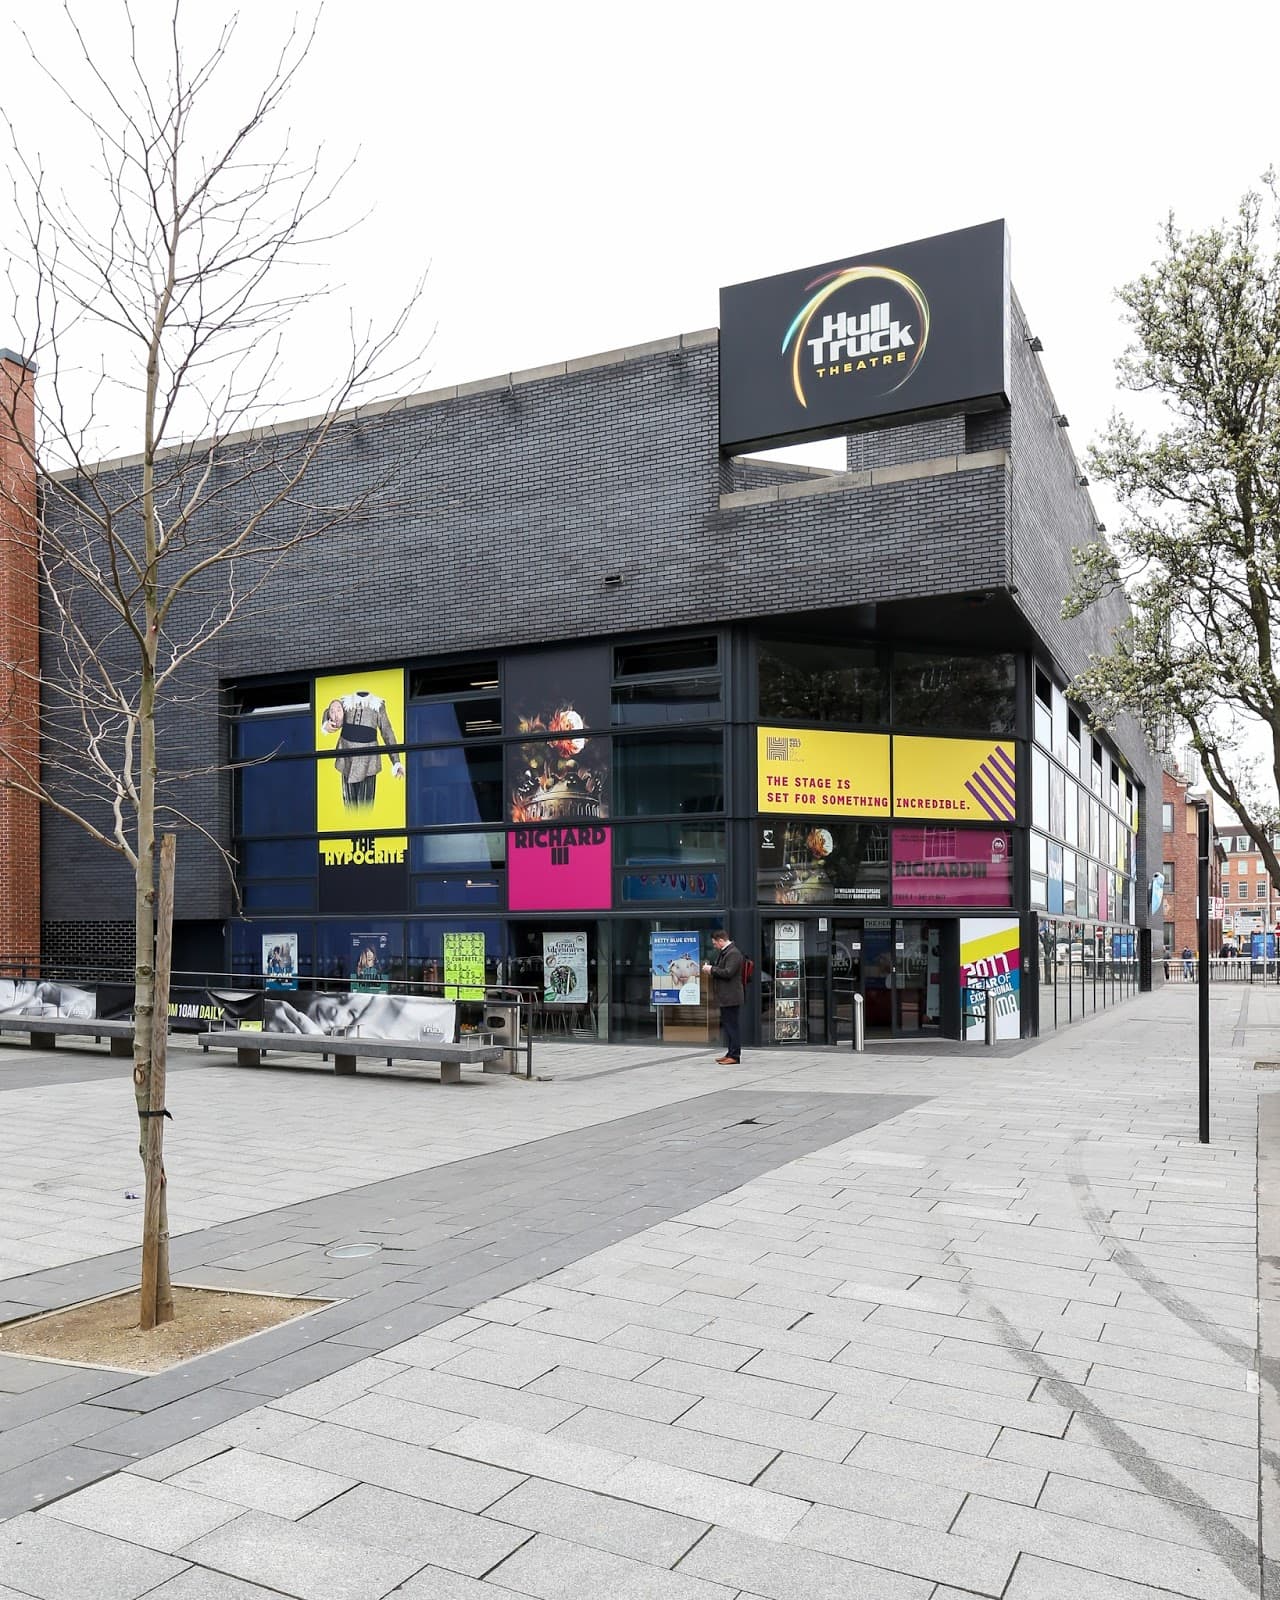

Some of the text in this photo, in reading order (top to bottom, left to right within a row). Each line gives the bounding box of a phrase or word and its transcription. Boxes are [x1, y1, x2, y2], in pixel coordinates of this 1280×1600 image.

[822, 302, 890, 341] Hull
[807, 320, 915, 365] Truck
[816, 351, 906, 378] THEATRE
[766, 775, 851, 790] THE STAGE IS
[767, 792, 971, 810] SET FOR SOMETHING INCREDIBLE.
[350, 837, 375, 851] THE
[514, 827, 606, 848] RICHARD
[324, 849, 404, 866] HYPOCRITE
[551, 846, 569, 865] III
[895, 861, 972, 877] RICHARD
[963, 952, 1010, 986] 2017
[997, 972, 1012, 985] OF
[178, 1003, 199, 1019] 10AM
[199, 1005, 225, 1021] DAILY
